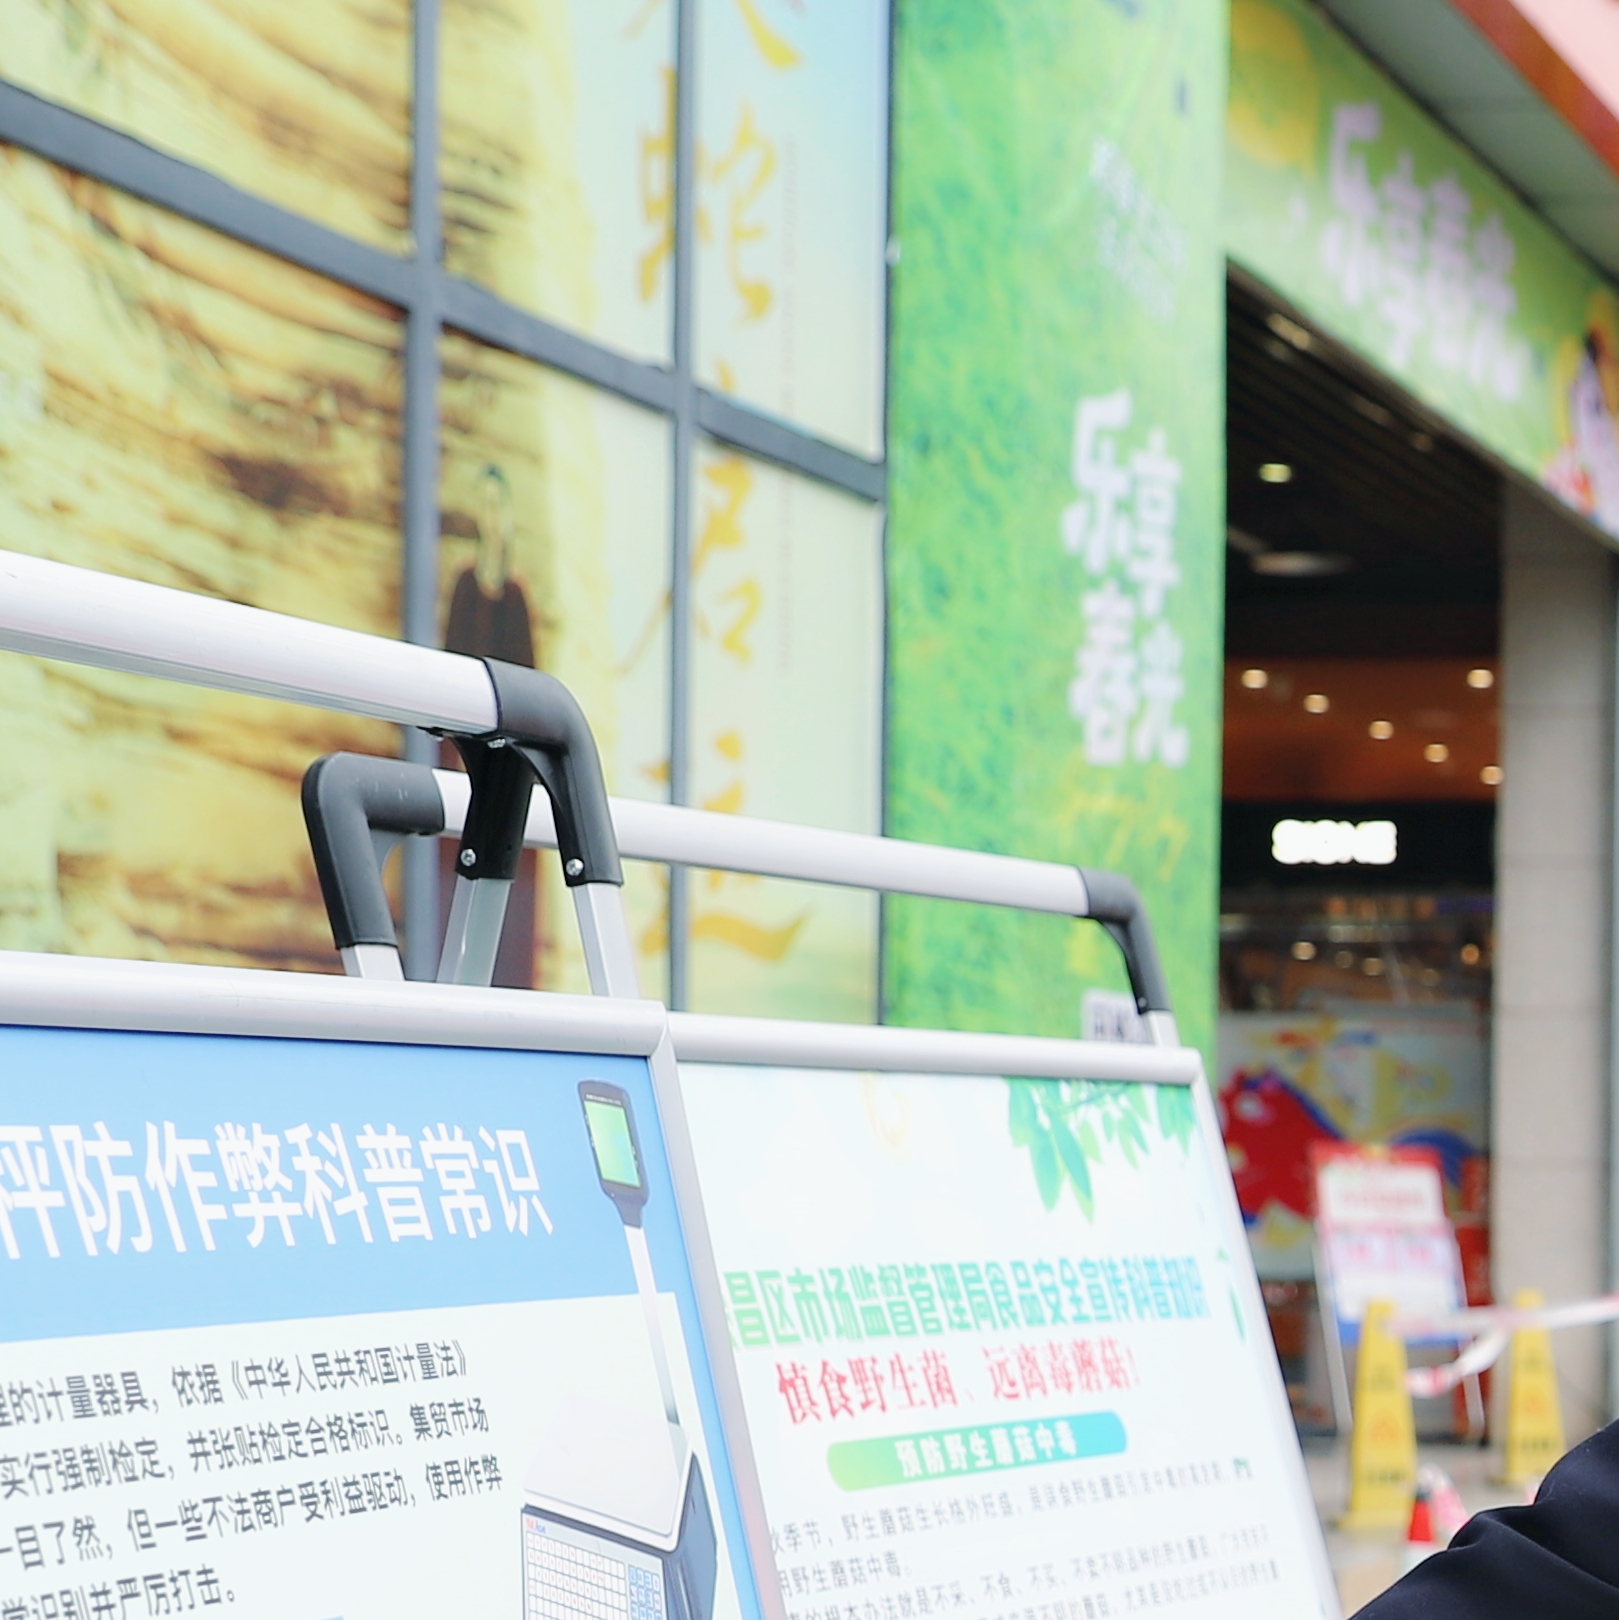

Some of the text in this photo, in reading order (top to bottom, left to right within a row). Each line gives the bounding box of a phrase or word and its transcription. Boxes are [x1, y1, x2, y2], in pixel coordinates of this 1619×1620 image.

[0, 1120, 554, 1260] 秤防作弊科普常识
[716, 1255, 1212, 1350] 昌区市场监督管理局食品安全宣传科普知识
